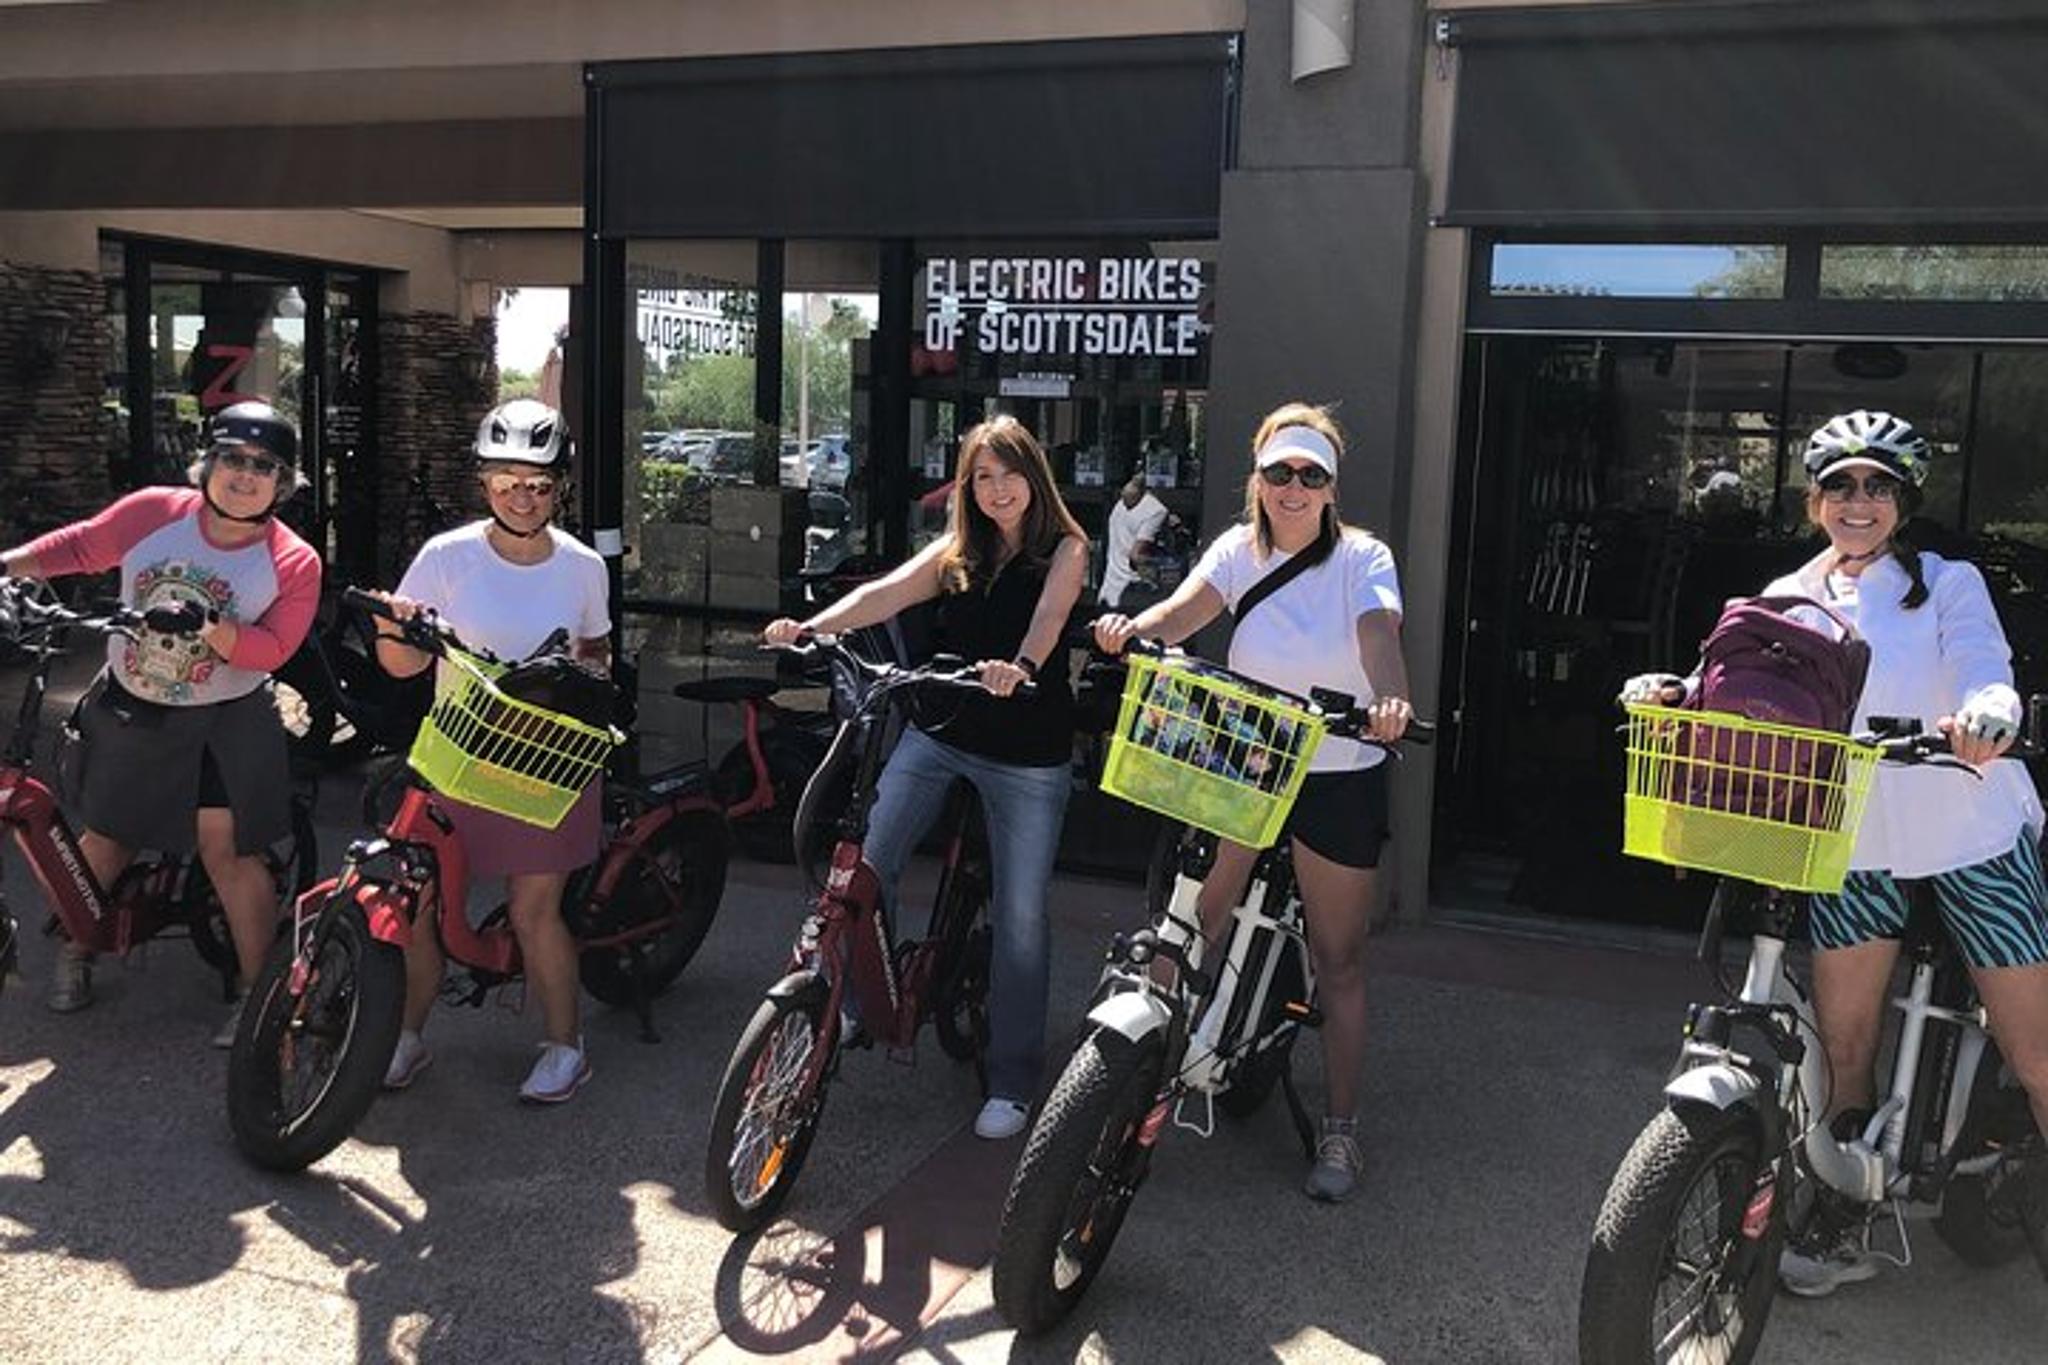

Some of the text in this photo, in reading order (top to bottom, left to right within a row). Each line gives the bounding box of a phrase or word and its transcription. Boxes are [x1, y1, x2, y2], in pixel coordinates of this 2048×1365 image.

[926, 258, 1201, 300] ELECTRIC BIKES
[926, 312, 1198, 356] OF SCOTTSDALE
